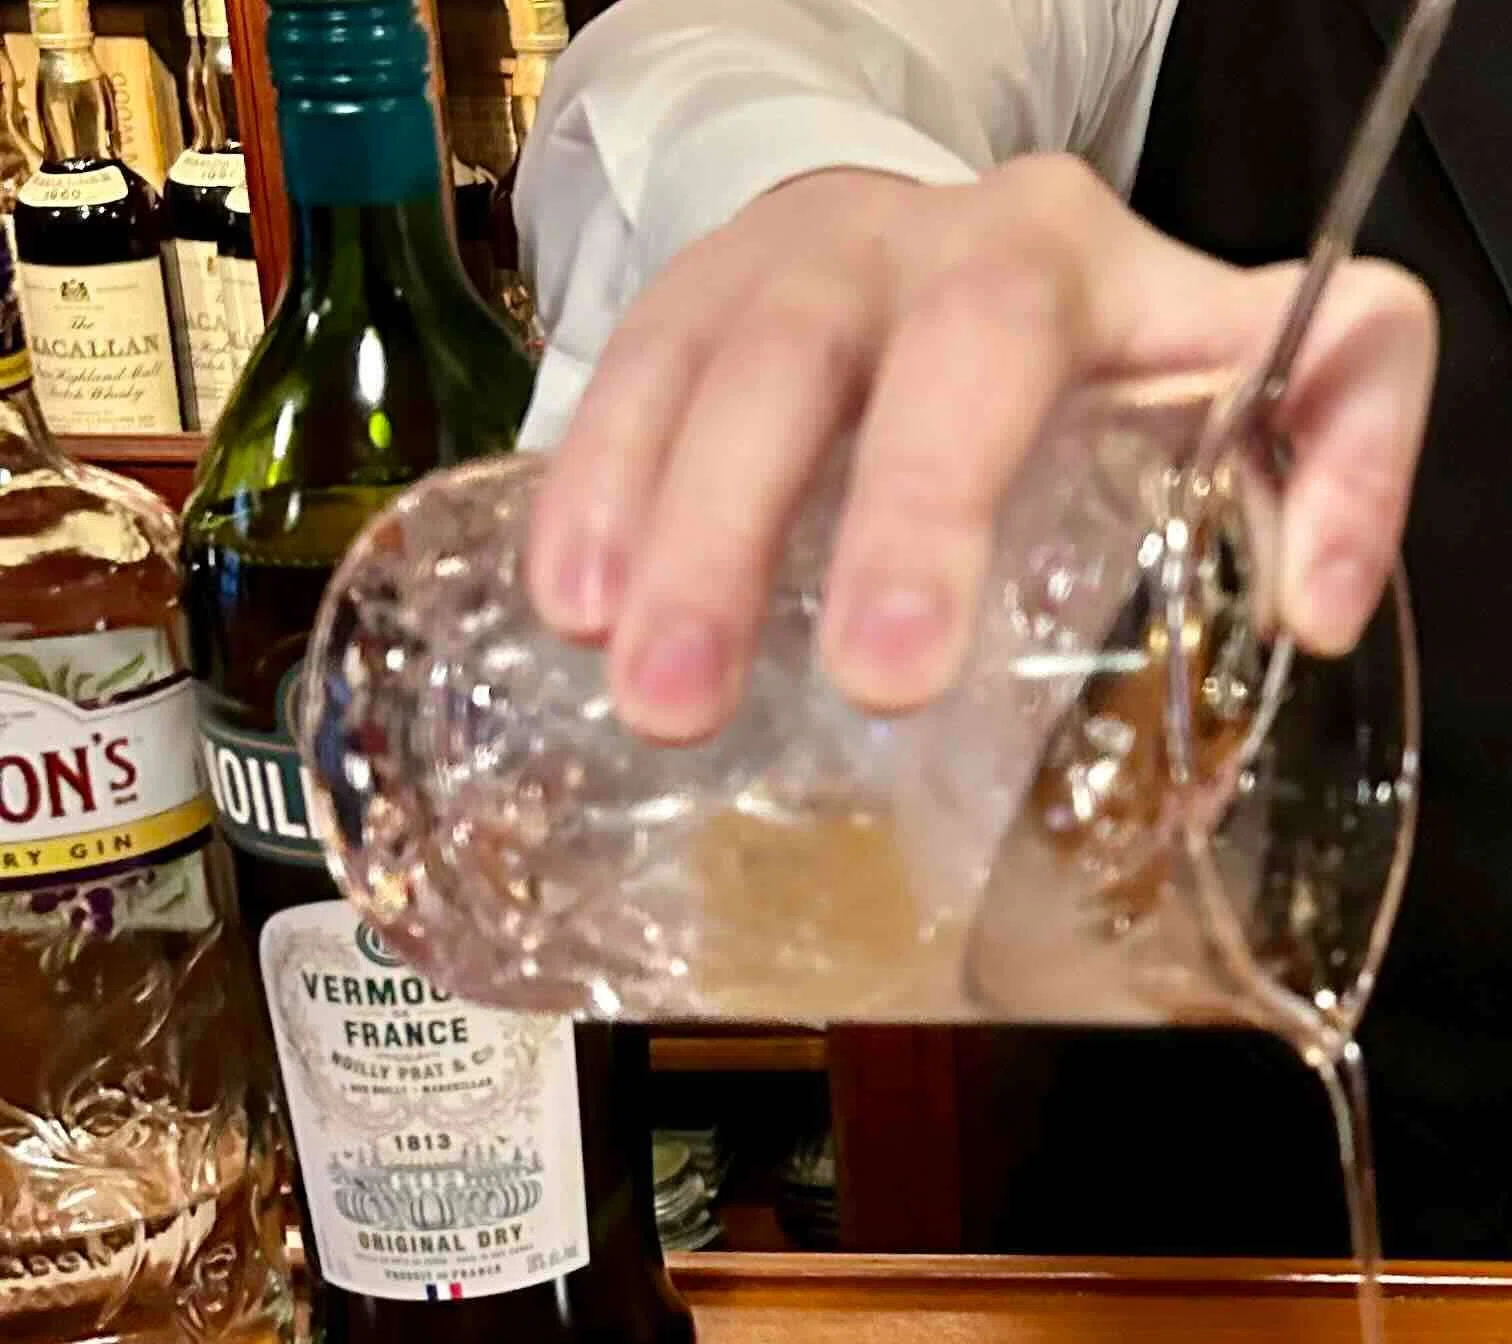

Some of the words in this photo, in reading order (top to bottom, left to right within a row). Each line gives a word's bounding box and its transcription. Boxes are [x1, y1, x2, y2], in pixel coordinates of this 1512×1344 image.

[69, 833, 132, 860] GIN
[344, 1017, 468, 1048] FRANCE
[331, 1051, 389, 1080] NOILLY
[398, 1063, 444, 1080] PRAT
[394, 1133, 451, 1151] 1813
[358, 1231, 466, 1254] ORIGINAL
[477, 1223, 523, 1248] DRY
